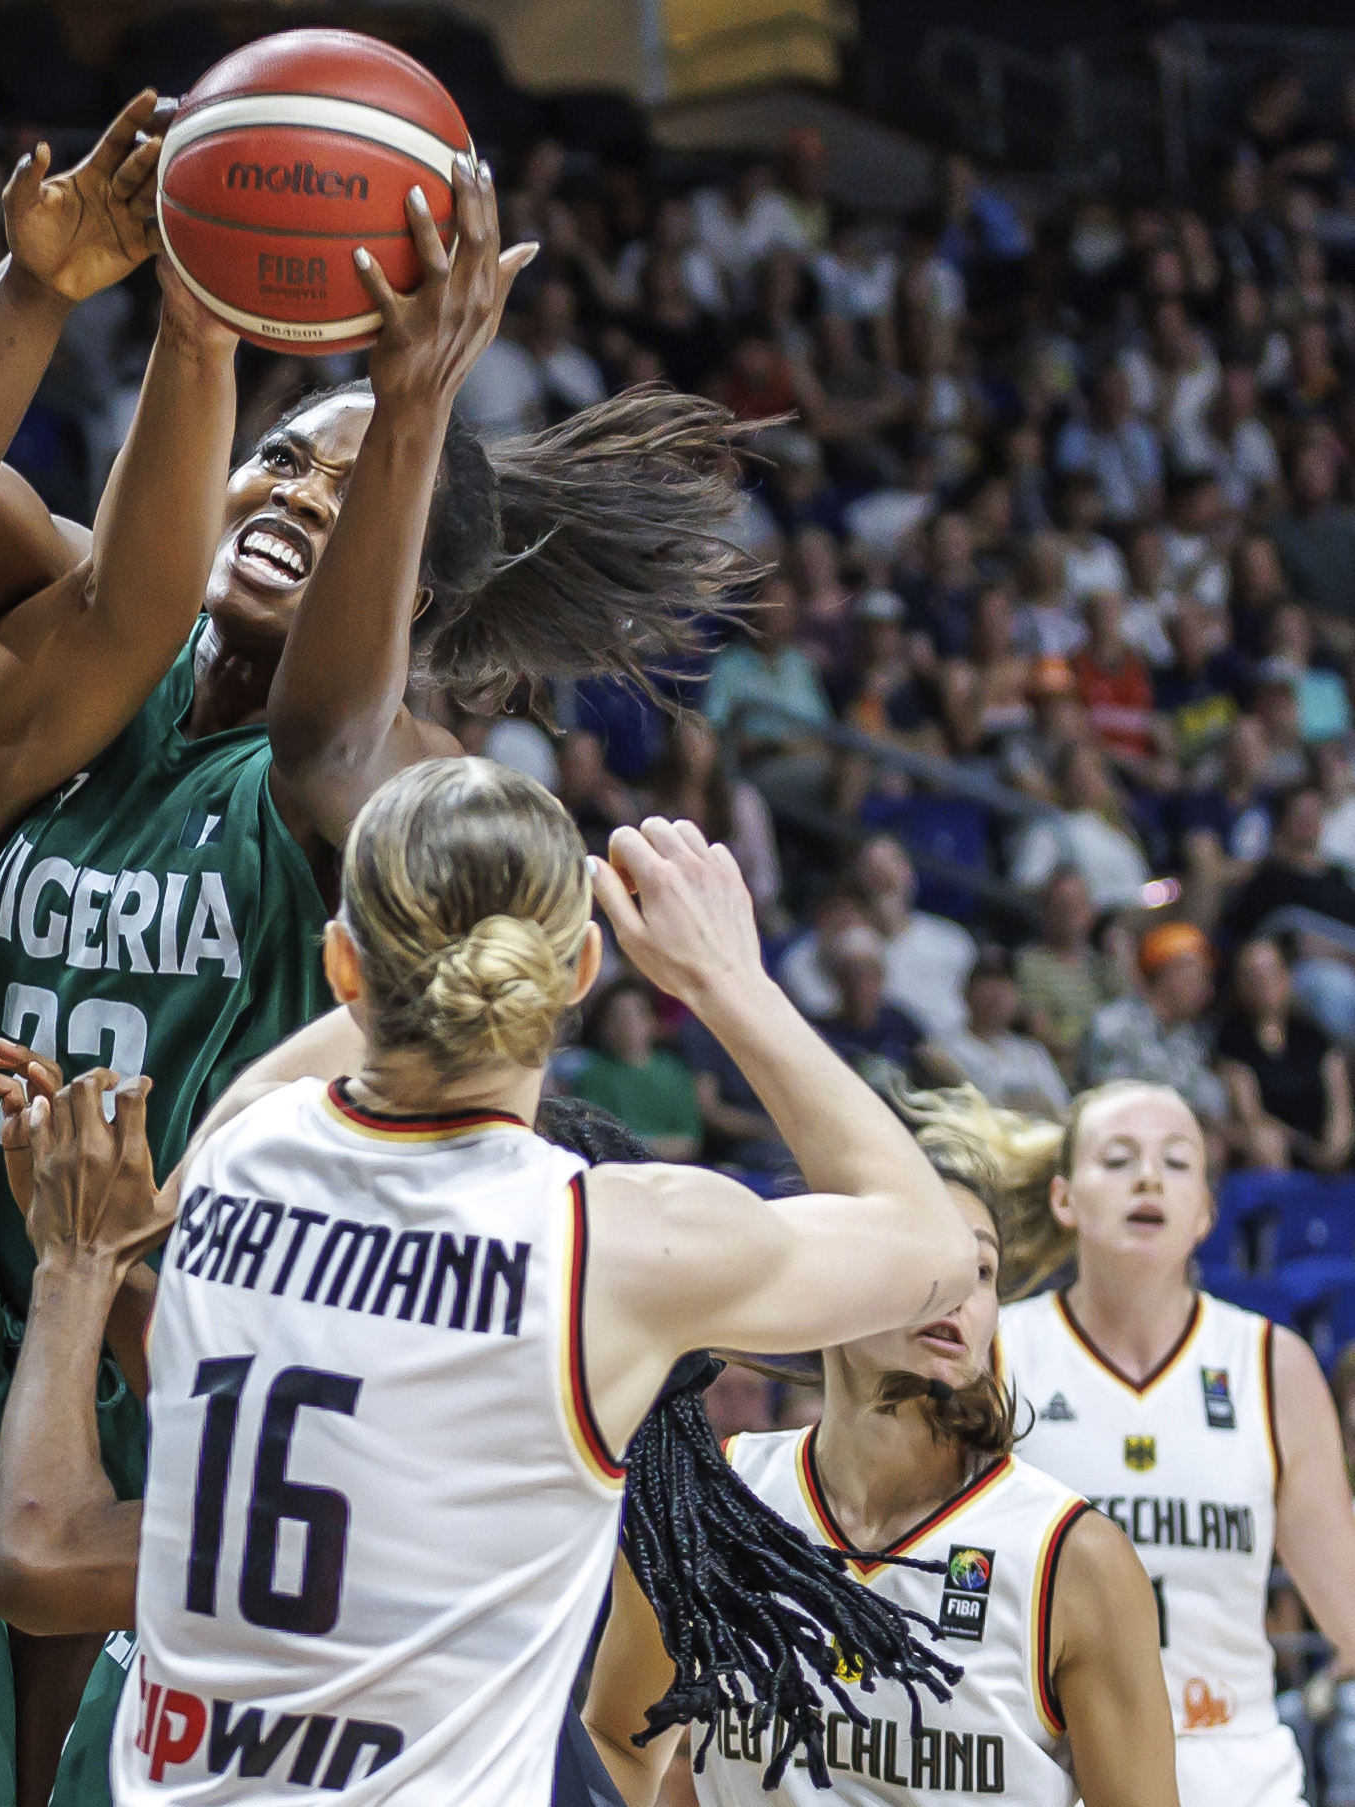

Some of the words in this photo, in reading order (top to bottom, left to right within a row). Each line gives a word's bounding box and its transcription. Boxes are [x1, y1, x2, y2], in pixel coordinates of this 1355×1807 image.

[227, 160, 369, 201] molten
[258, 252, 327, 285] FIBA
[176, 1185, 532, 1337] HARTMANN
[186, 1354, 364, 1637] 16
[947, 1597, 981, 1620] FIBA
